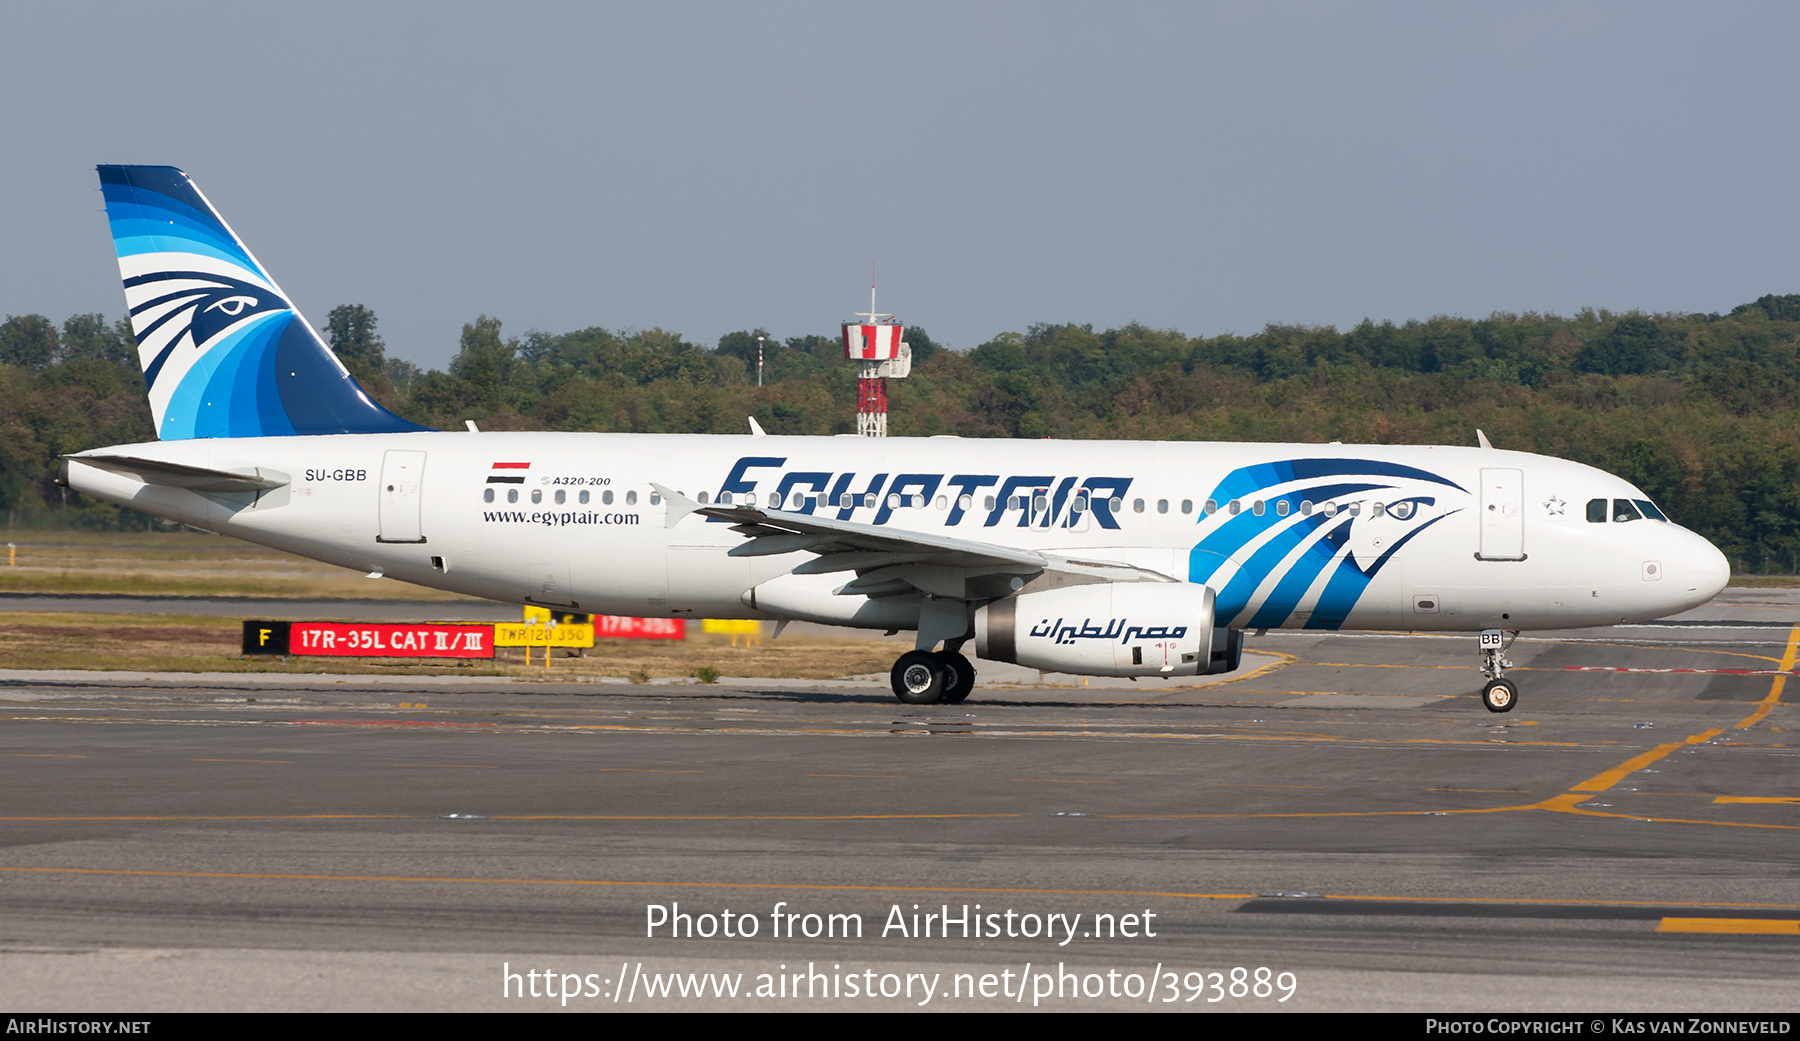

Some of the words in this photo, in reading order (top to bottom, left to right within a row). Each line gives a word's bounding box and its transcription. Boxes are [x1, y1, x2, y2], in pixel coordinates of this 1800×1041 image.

[305, 468, 367, 482] SU-GBB
[552, 476, 611, 486] A320-200
[705, 457, 1135, 530] EGYPTAIR
[483, 510, 640, 527] www.egyptair.com
[259, 628, 272, 646] F
[501, 628, 527, 641] TWR
[1029, 617, 1127, 645] للطيران
[1121, 626, 1188, 645] مصر
[1482, 634, 1500, 645] BB
[302, 630, 386, 649] 17R-35L
[390, 631, 429, 650] CAT
